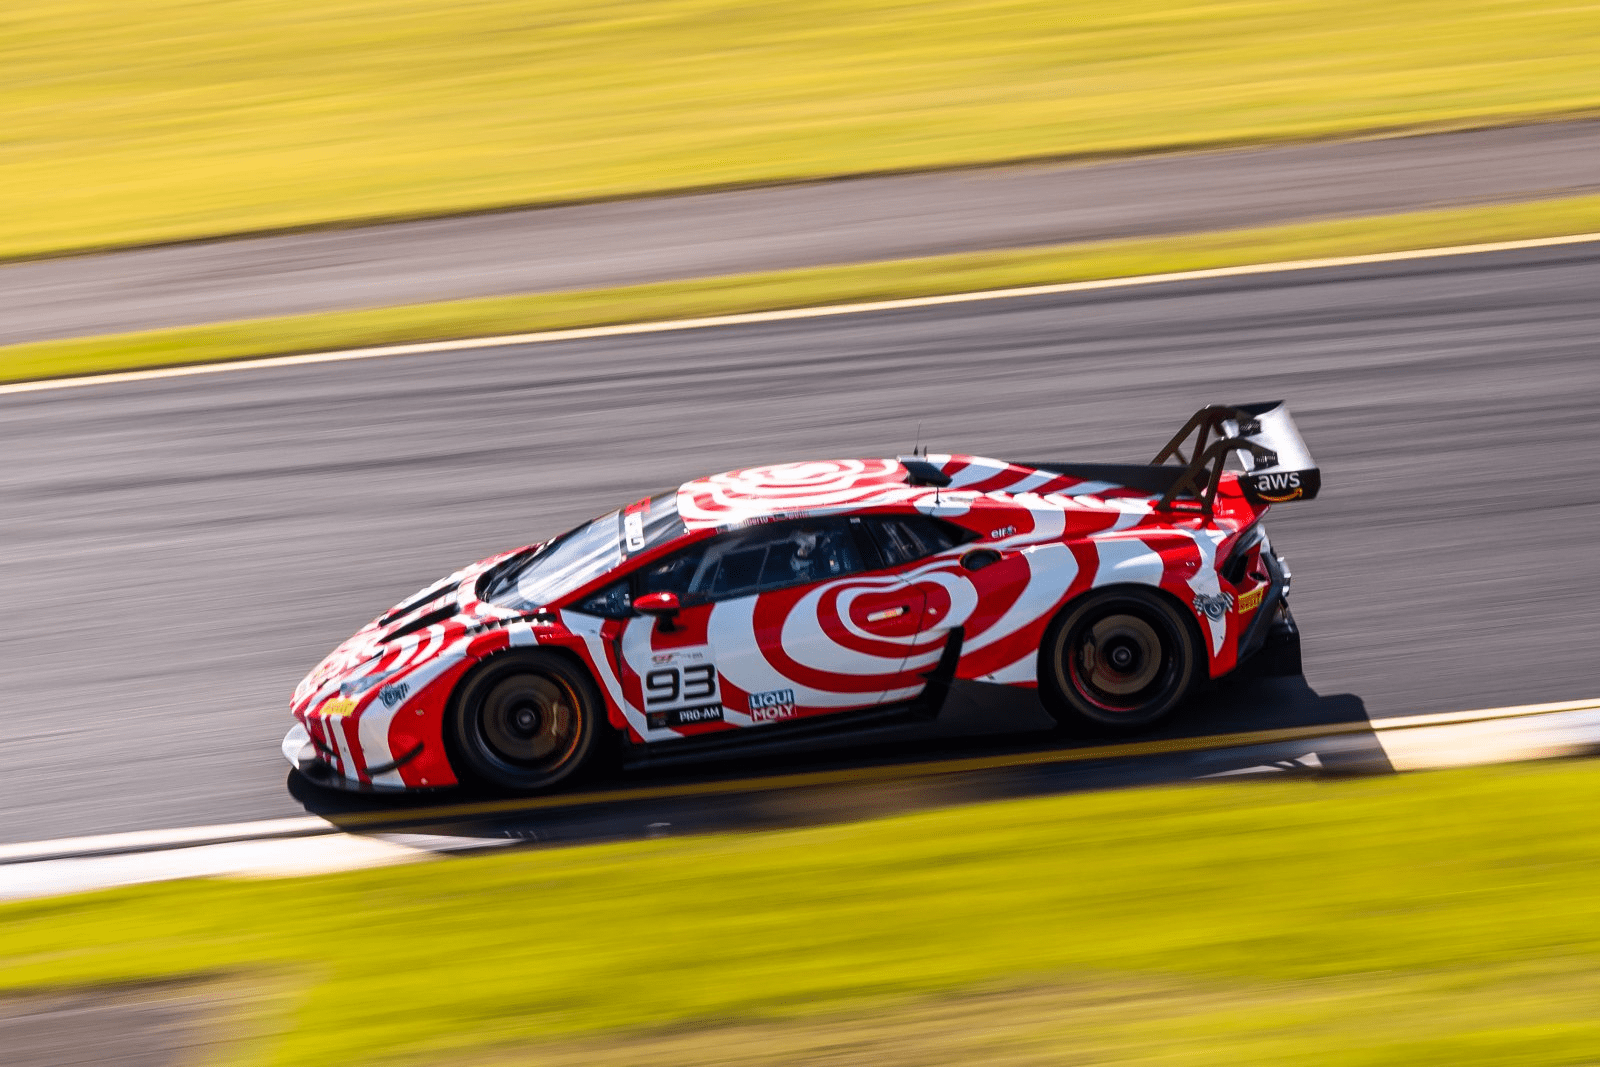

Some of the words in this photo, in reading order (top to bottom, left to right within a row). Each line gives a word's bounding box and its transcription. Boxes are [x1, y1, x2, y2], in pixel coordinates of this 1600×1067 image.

[1258, 472, 1301, 491] aws
[646, 663, 716, 705] 93
[750, 690, 792, 708] LIQUI
[679, 707, 720, 722] PRO-AM
[752, 705, 793, 721] MOLY
